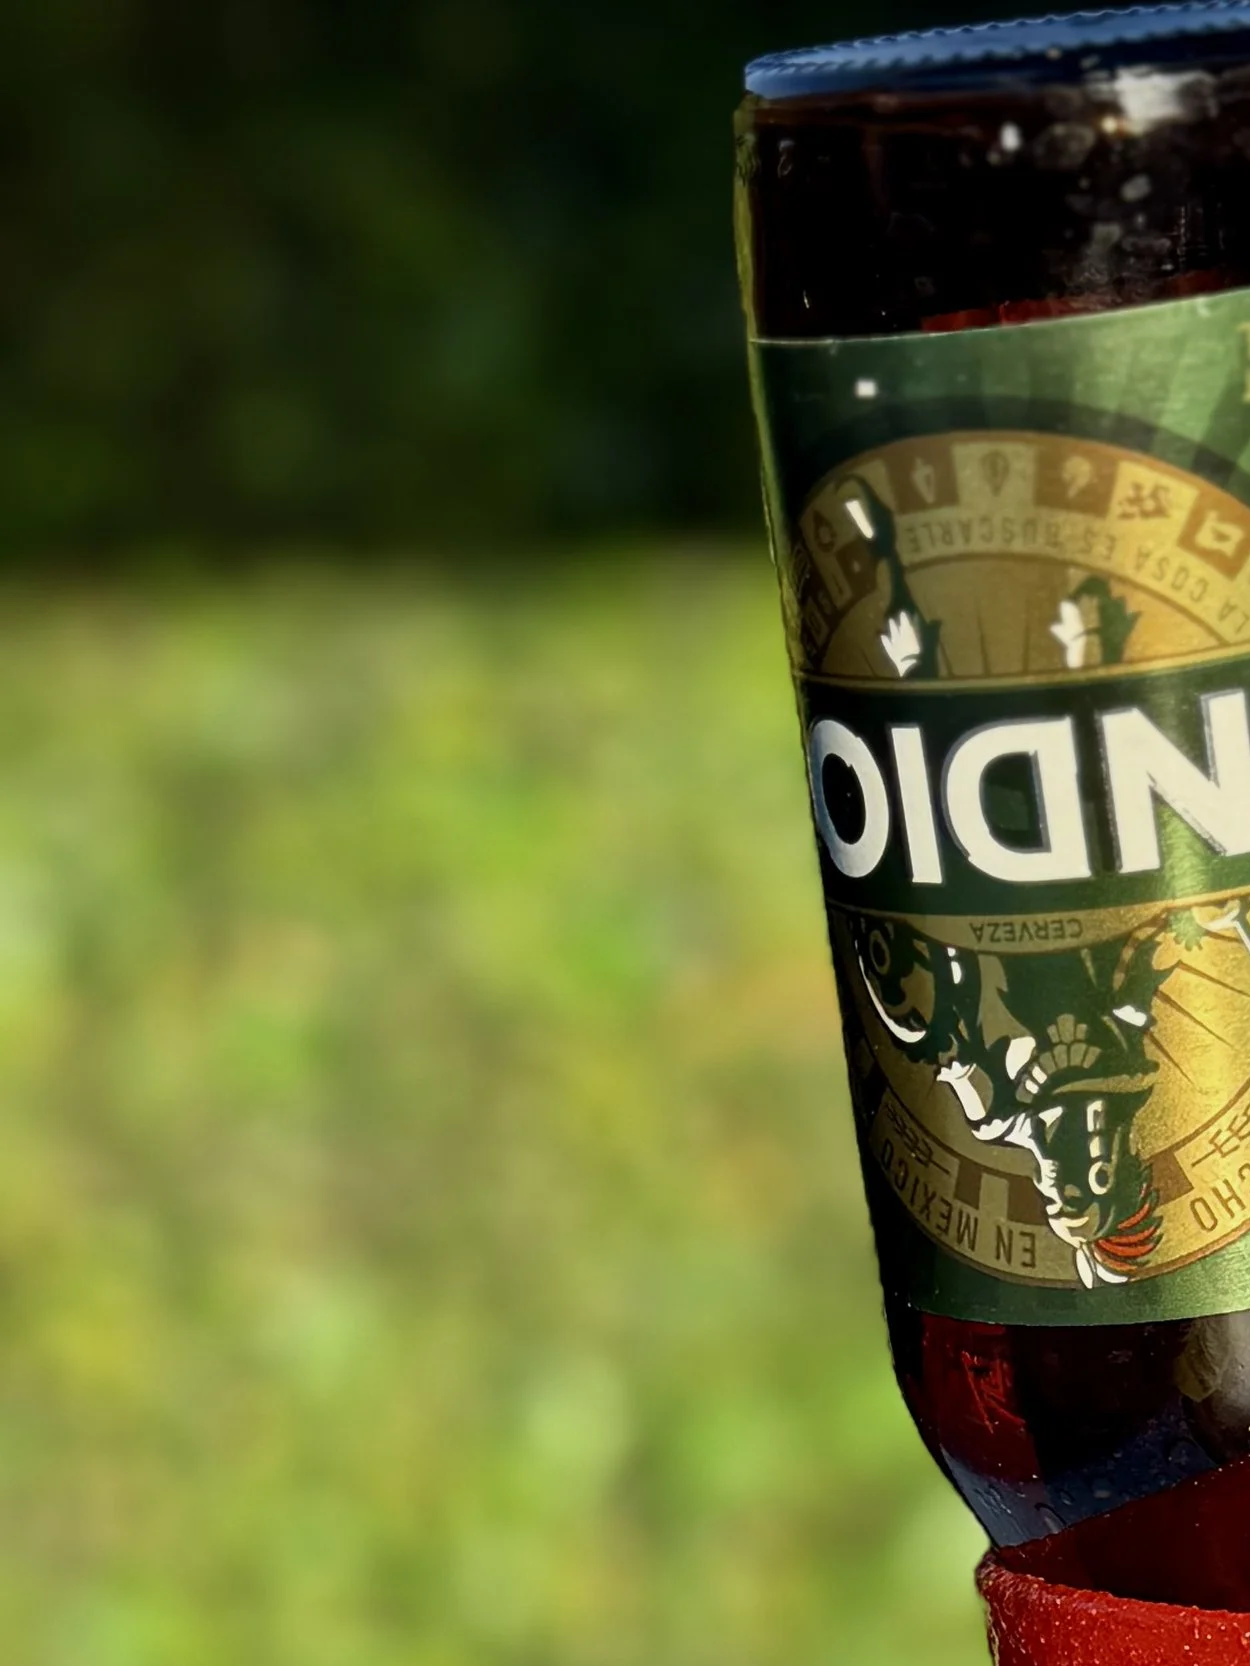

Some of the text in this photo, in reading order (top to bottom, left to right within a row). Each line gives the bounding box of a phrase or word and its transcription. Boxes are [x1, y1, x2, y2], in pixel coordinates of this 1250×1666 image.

[903, 516, 1250, 635] LA COSA ES BUSCARLE
[968, 917, 1084, 944] CERVEZA
[994, 1231, 1037, 1268] EN
